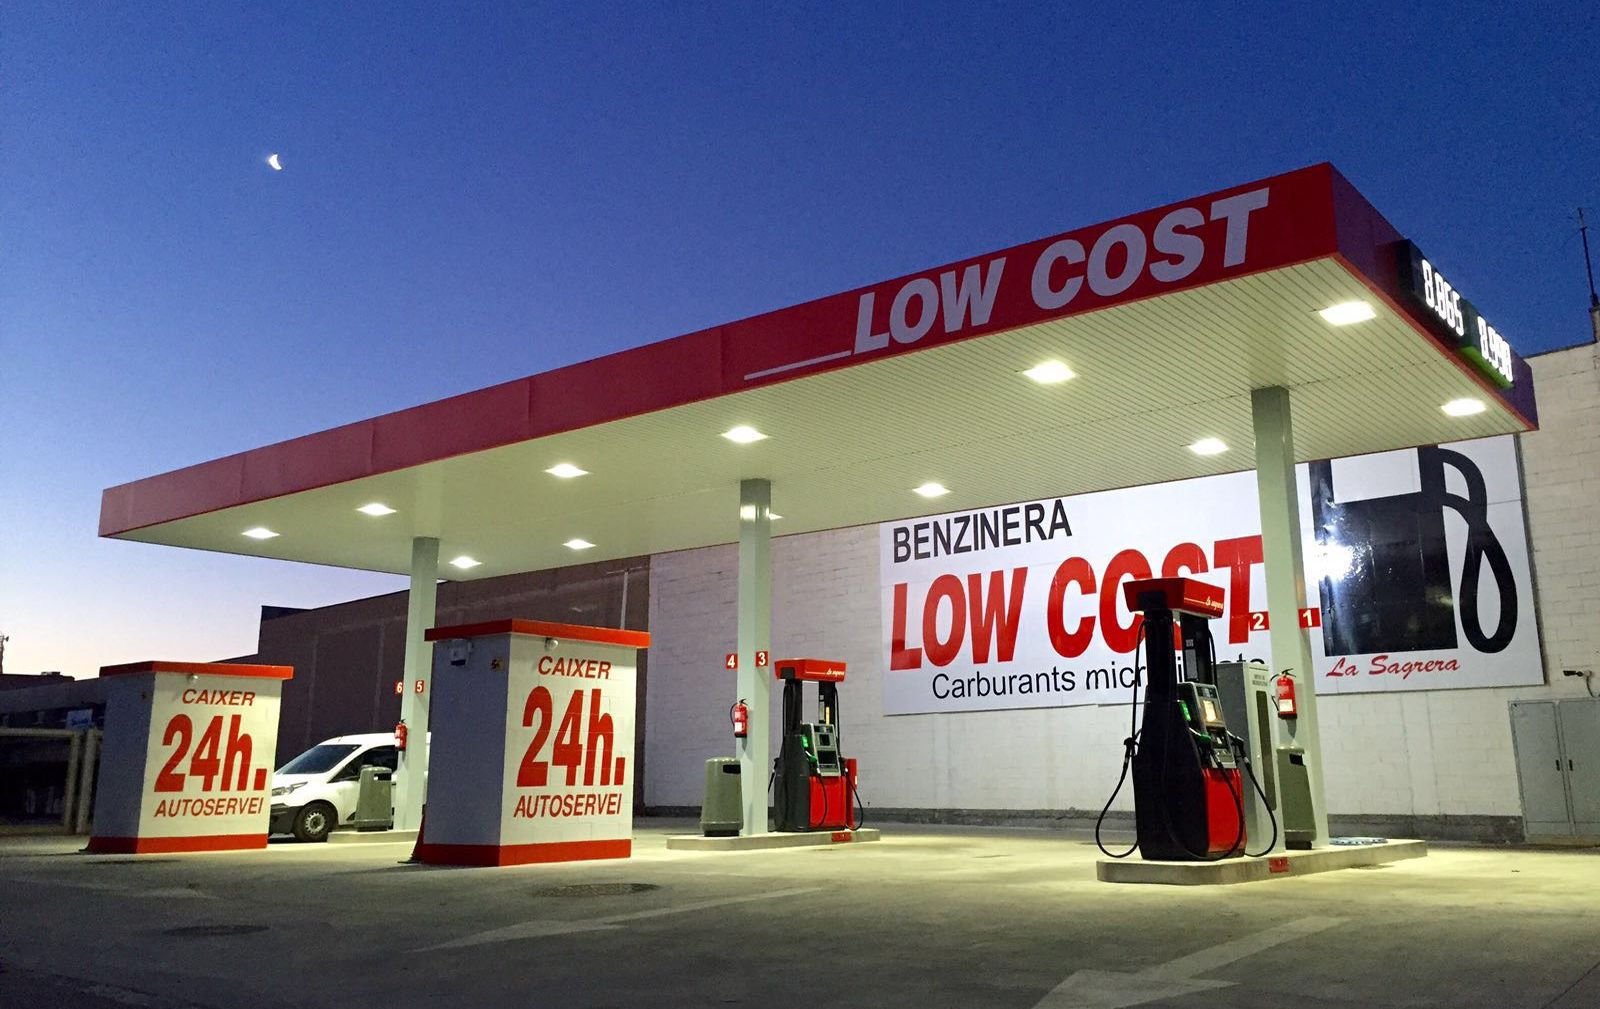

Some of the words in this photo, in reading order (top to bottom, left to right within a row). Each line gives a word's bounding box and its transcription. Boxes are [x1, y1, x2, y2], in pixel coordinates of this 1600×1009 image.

[853, 256, 1007, 354] LOW
[1031, 187, 1270, 310] COST
[893, 498, 1073, 564] BENZINERA
[890, 566, 1028, 672] LOW
[1252, 613, 1265, 630] 2
[1303, 609, 1313, 626] 1
[536, 656, 612, 680] CAIXER
[727, 654, 736, 668] 4
[758, 652, 767, 666] 3
[1326, 656, 1359, 677] La
[1369, 654, 1461, 680] Sagrera
[396, 682, 403, 693] 6
[416, 681, 424, 693] 5
[932, 664, 1076, 701] Carburants
[182, 690, 255, 705] CAIXER
[515, 685, 626, 789] 24h.
[154, 713, 268, 793] 24h.
[154, 796, 264, 818] AUTOSERVEI
[514, 792, 622, 820] AUTOSERVEI
